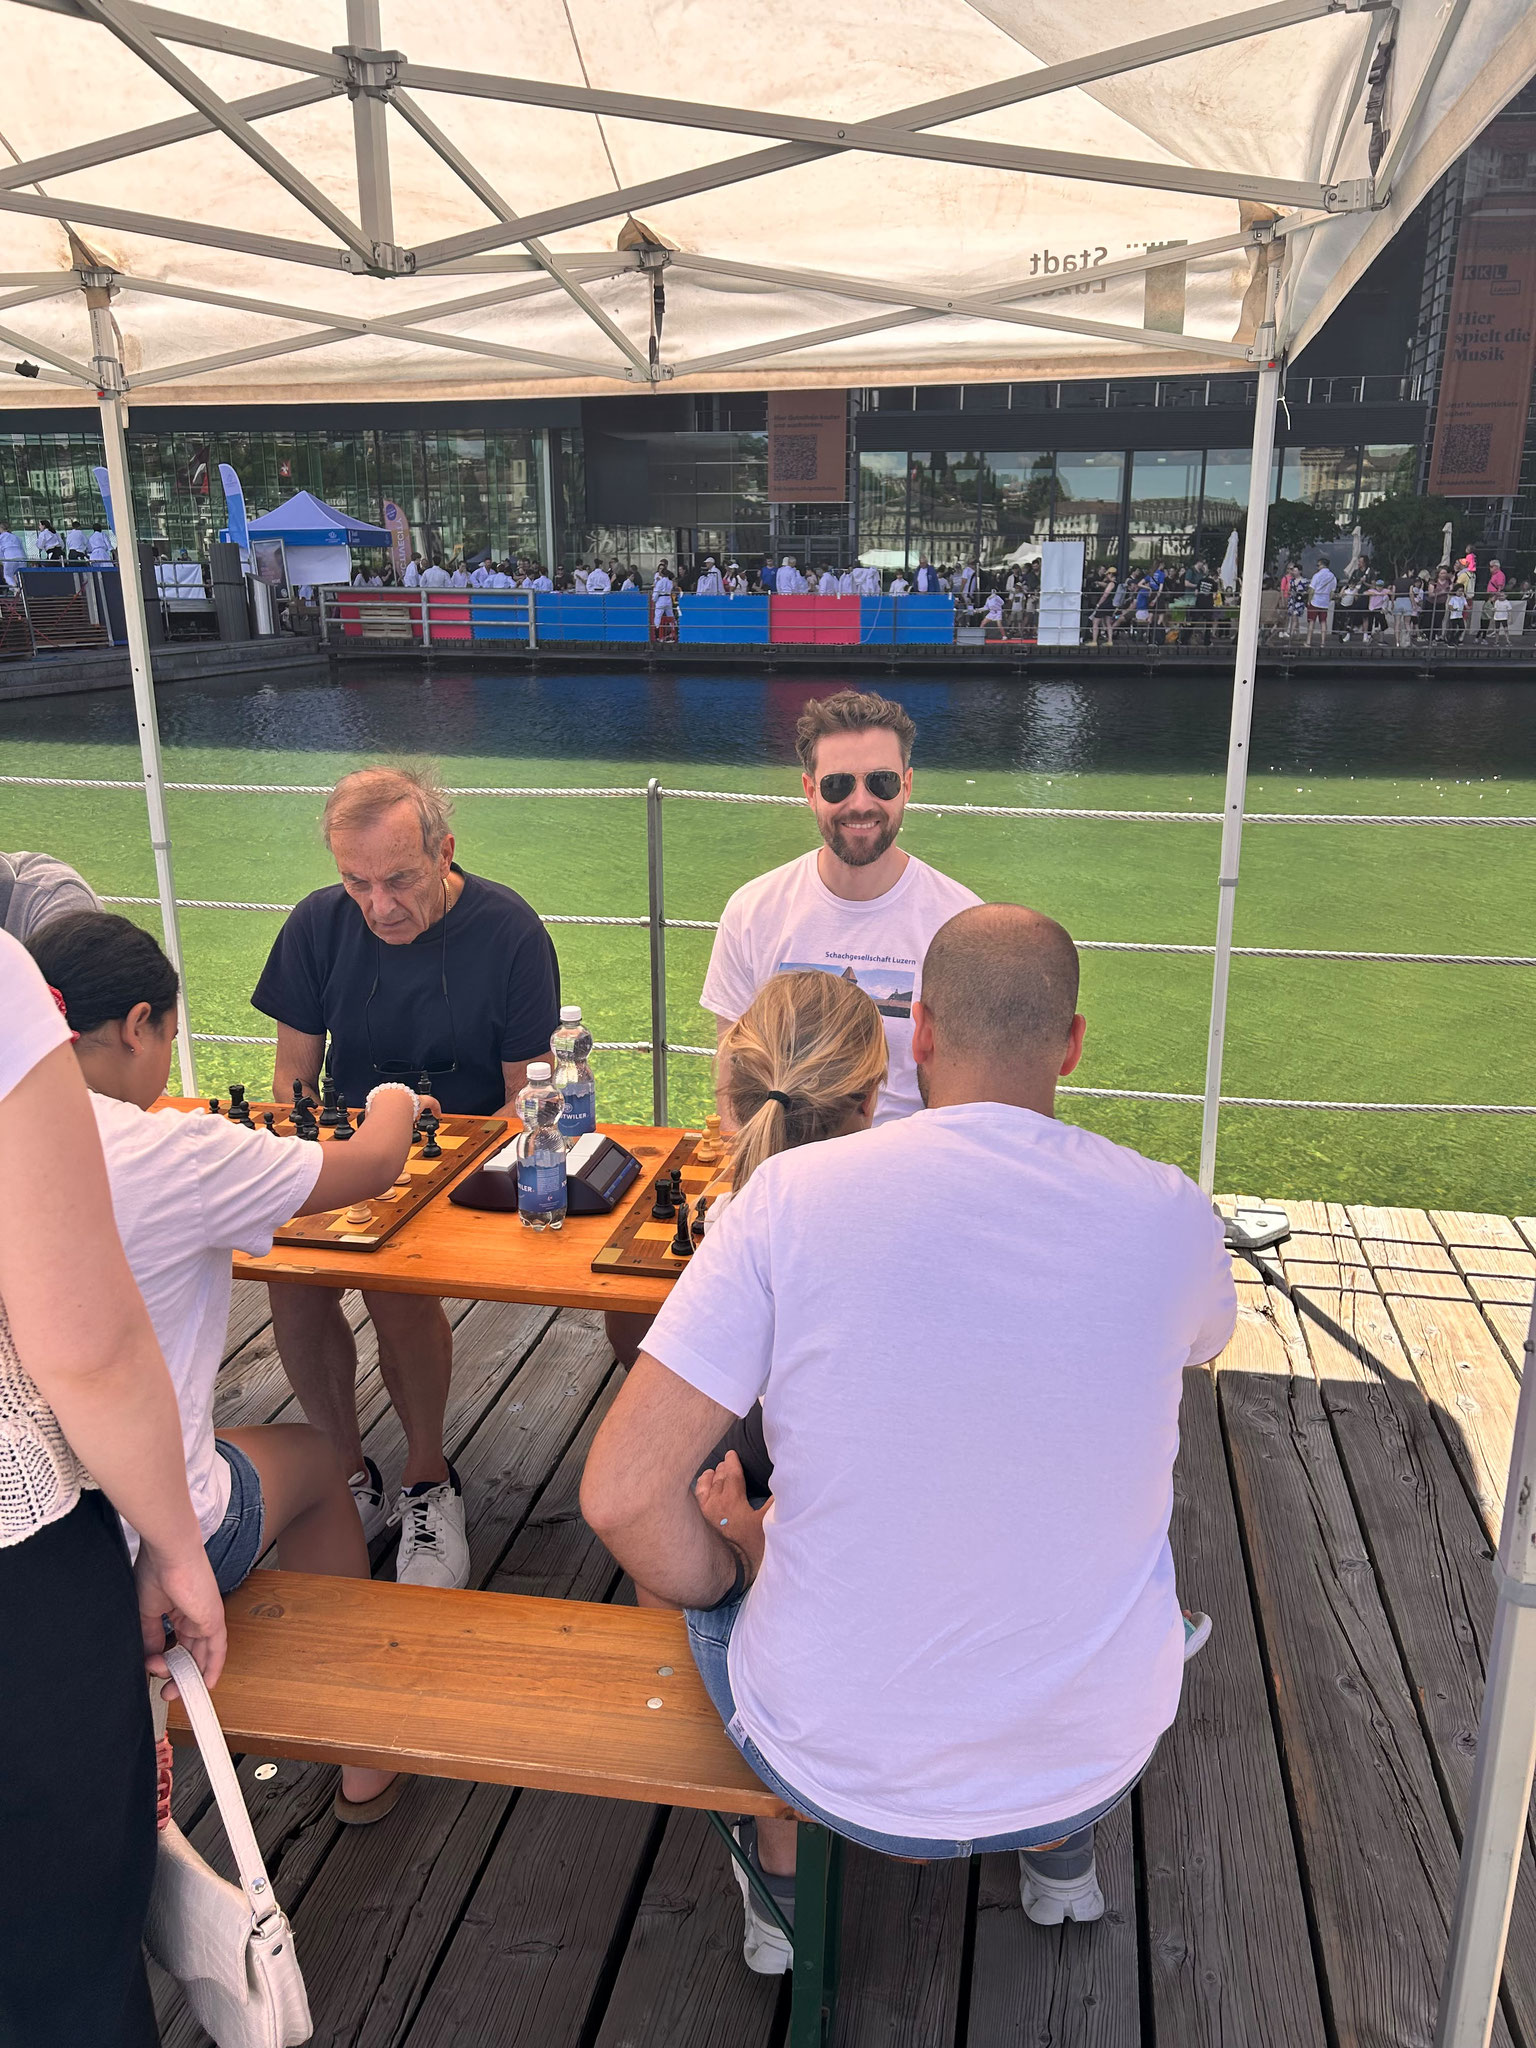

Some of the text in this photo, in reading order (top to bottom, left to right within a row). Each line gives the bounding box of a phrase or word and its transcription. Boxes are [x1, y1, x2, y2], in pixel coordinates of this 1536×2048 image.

[1463, 265, 1507, 280] KKL
[1457, 312, 1495, 325] Hier
[1455, 328, 1530, 346] spielt die
[1455, 347, 1504, 361] Musik
[825, 951, 916, 965] Schachgesellschaft Luzern
